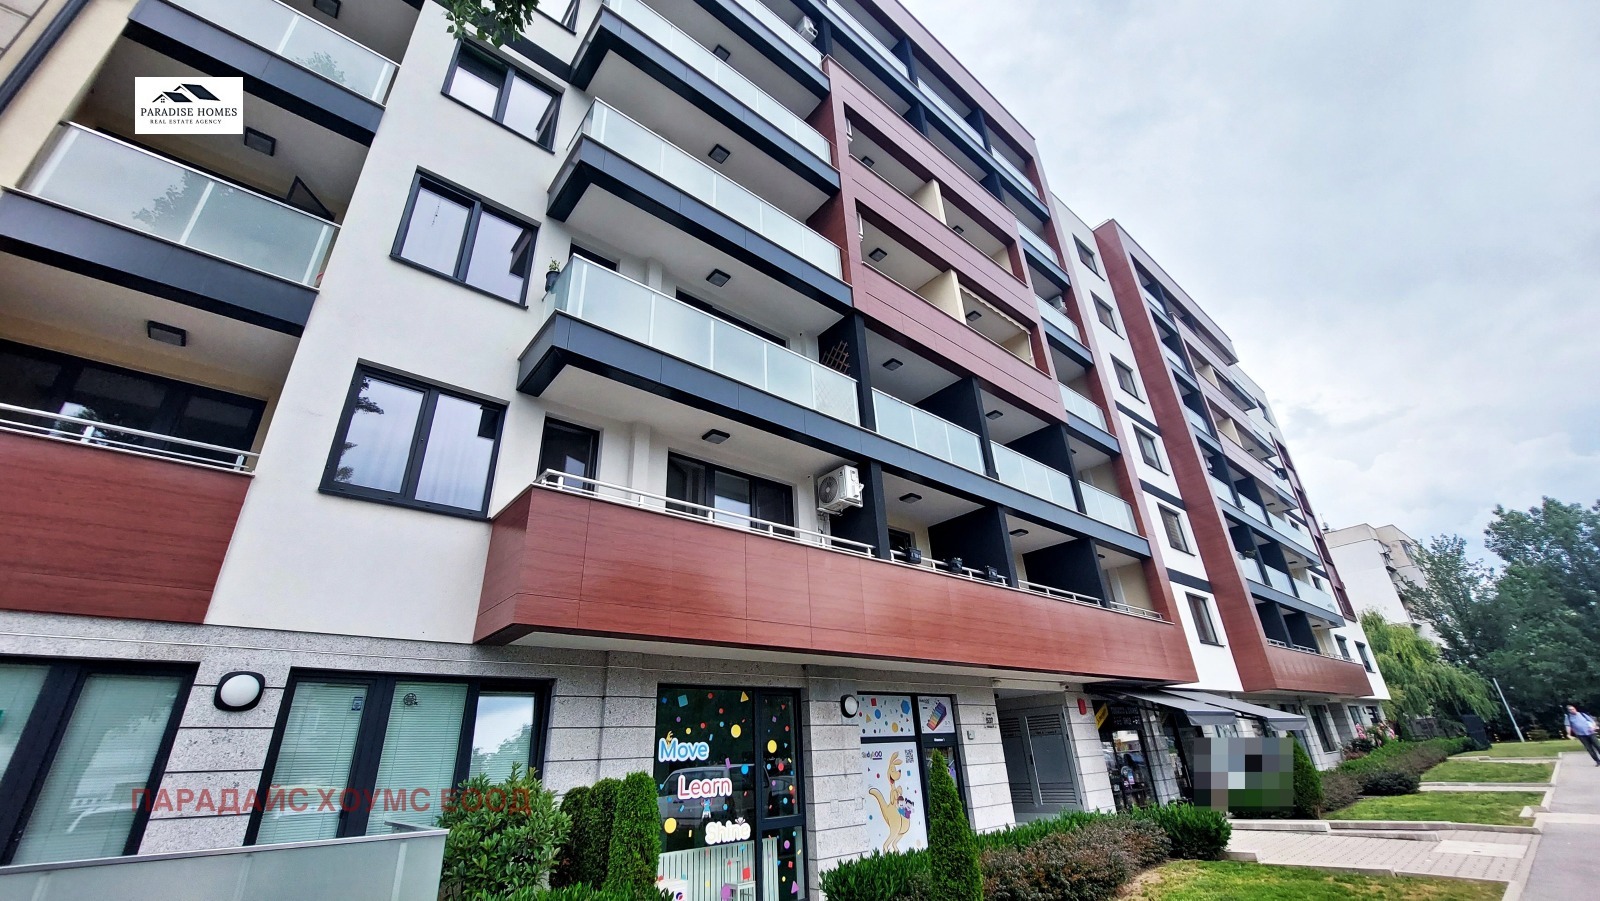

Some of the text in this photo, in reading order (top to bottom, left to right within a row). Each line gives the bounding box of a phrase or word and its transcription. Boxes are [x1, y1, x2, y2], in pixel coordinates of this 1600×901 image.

[659, 738, 709, 762] Move
[678, 775, 732, 799] Learn
[705, 820, 751, 845] Shine
